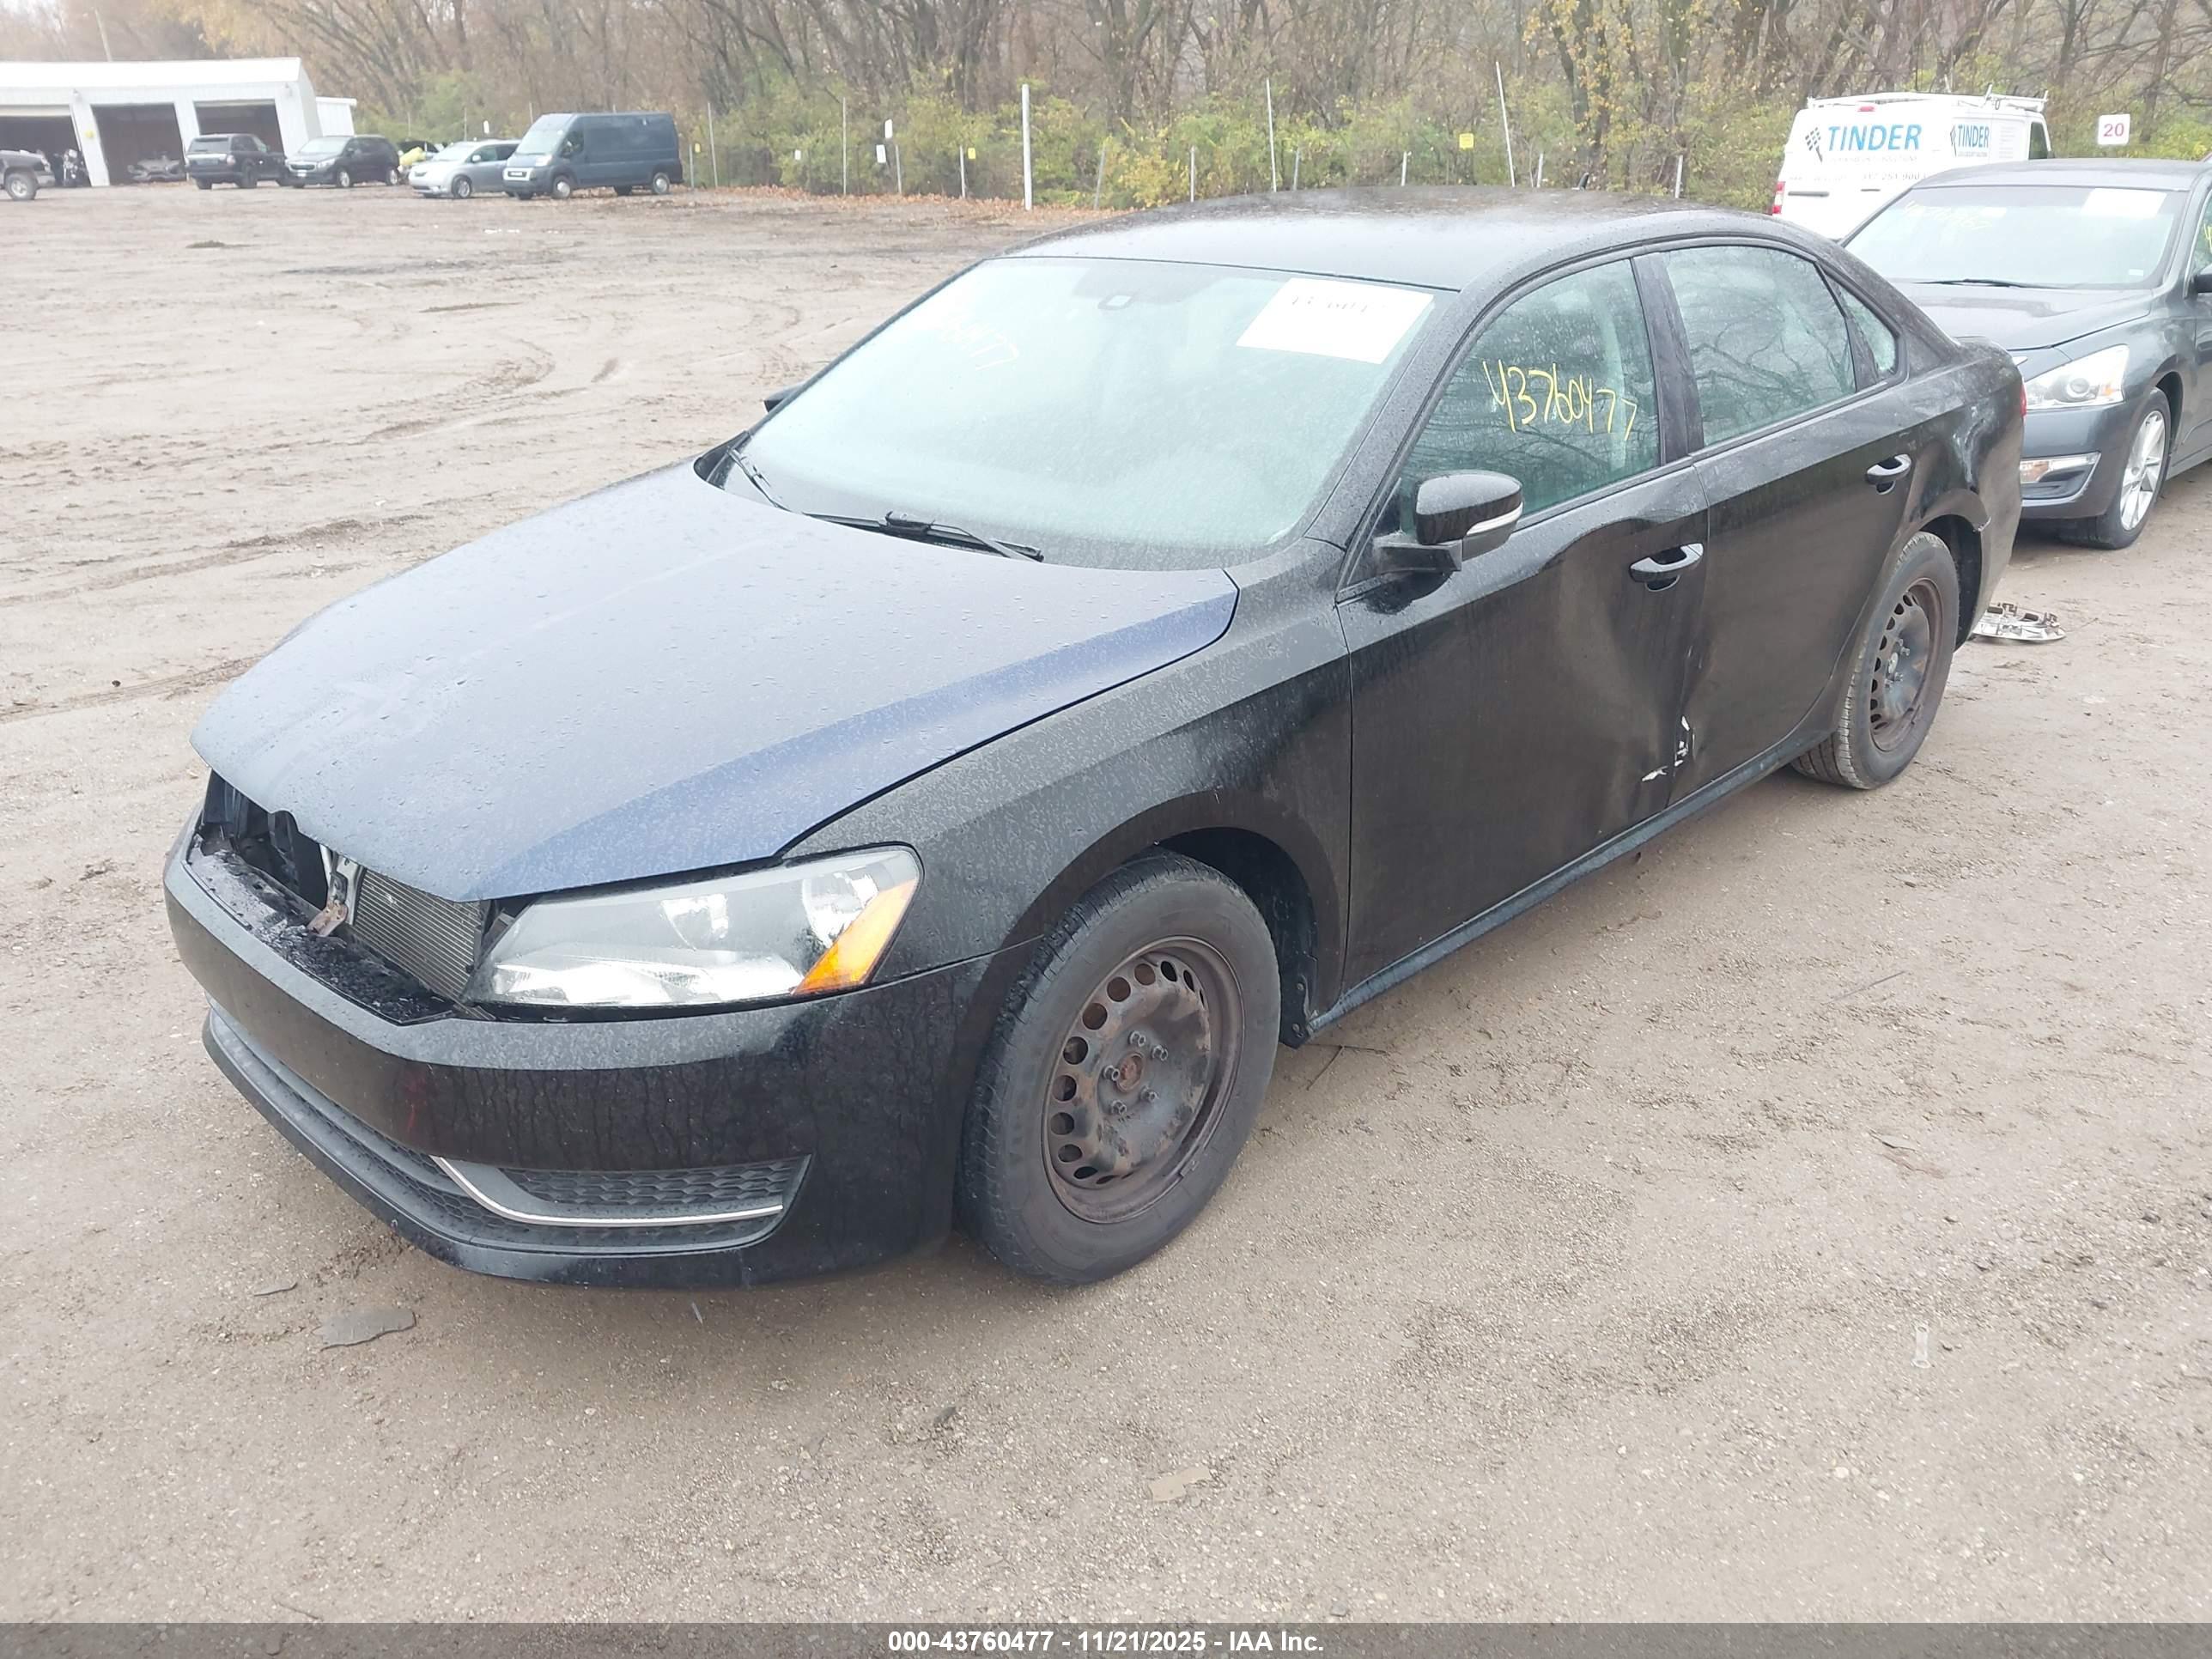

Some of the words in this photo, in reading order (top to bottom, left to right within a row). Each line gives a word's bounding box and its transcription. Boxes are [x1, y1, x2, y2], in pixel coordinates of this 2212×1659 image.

[1828, 124, 1923, 152] TINDER
[1957, 124, 1990, 149] TINDER
[2103, 123, 2124, 137] 20
[1482, 359, 1638, 441] 43760477
